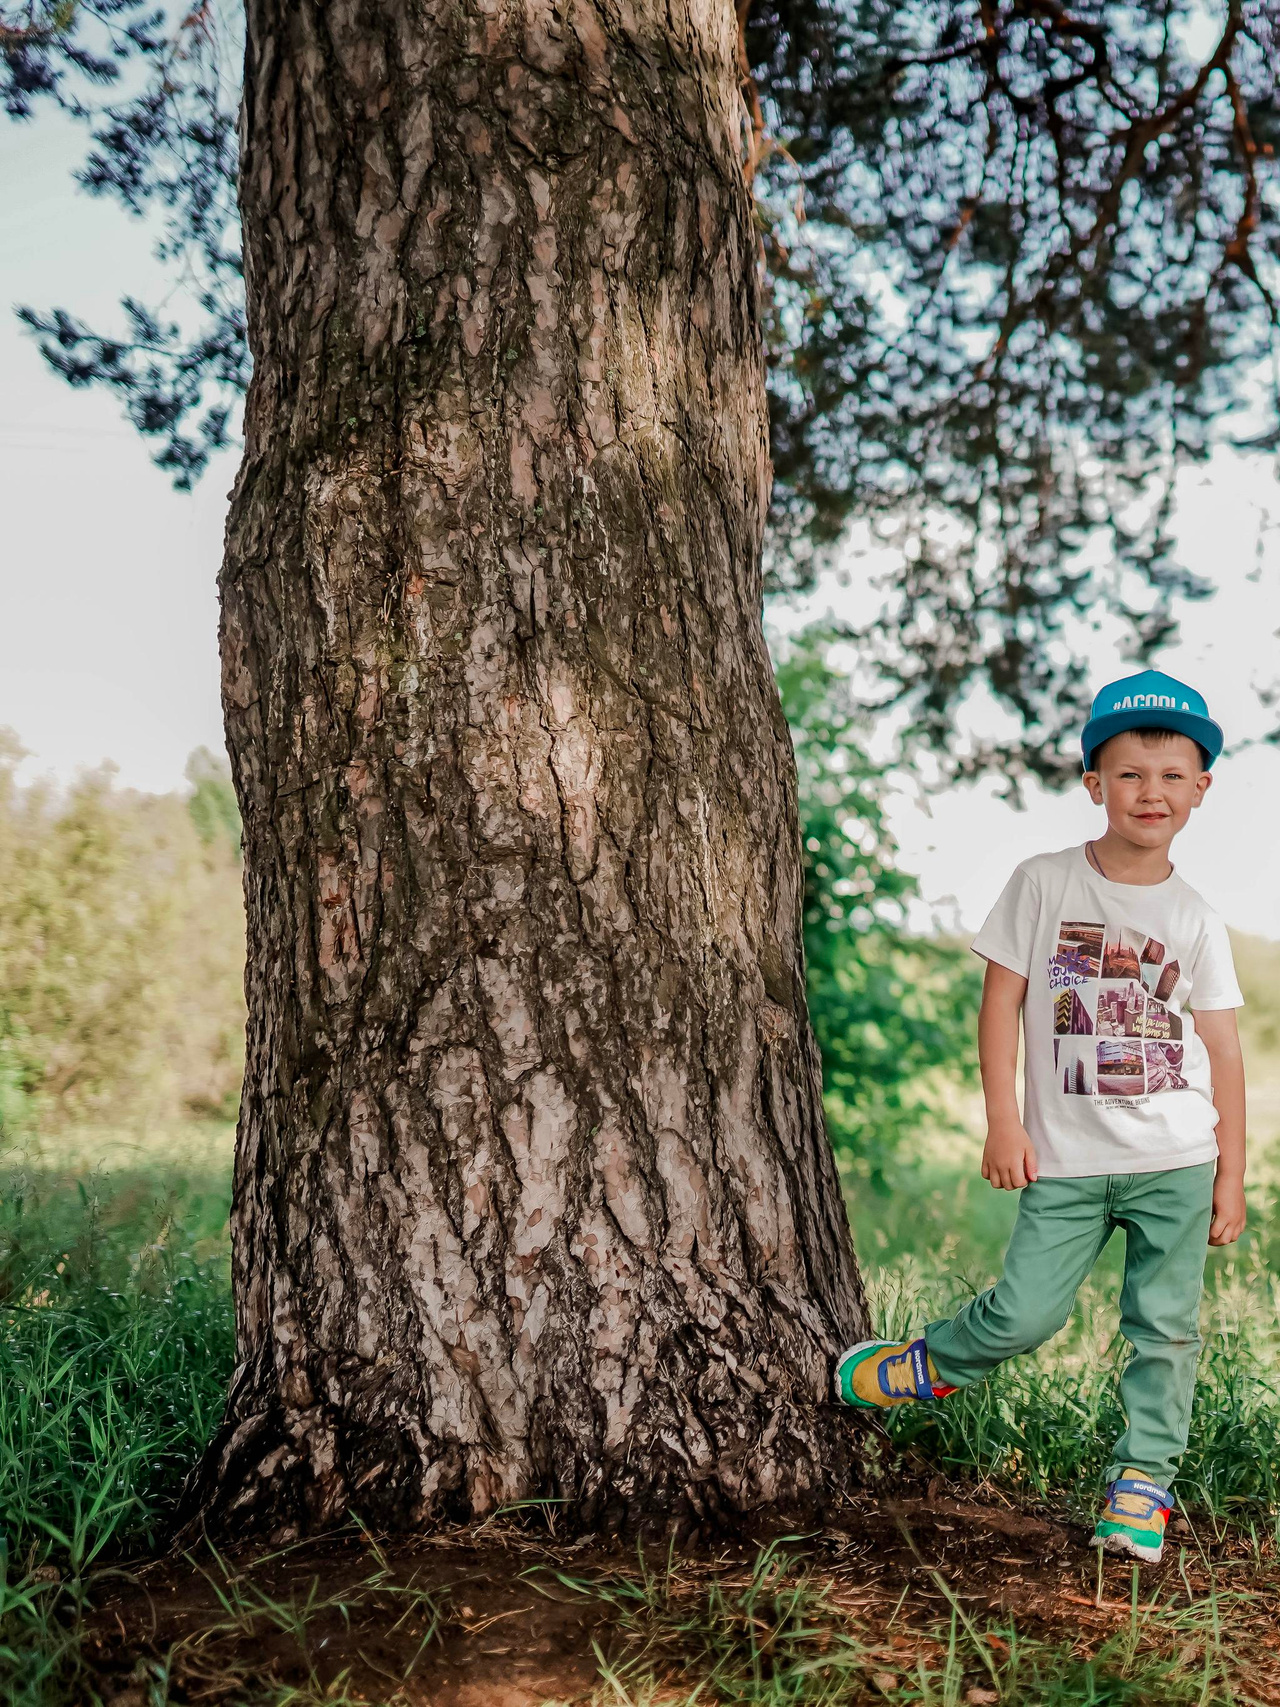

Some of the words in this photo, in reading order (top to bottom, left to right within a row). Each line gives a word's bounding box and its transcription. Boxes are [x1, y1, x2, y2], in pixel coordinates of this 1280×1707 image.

[1049, 975, 1089, 989] CHOICE
[1105, 1098, 1134, 1106] ADVENTURE
[915, 1349, 925, 1385] Nordman
[1133, 1482, 1166, 1499] Nordman
